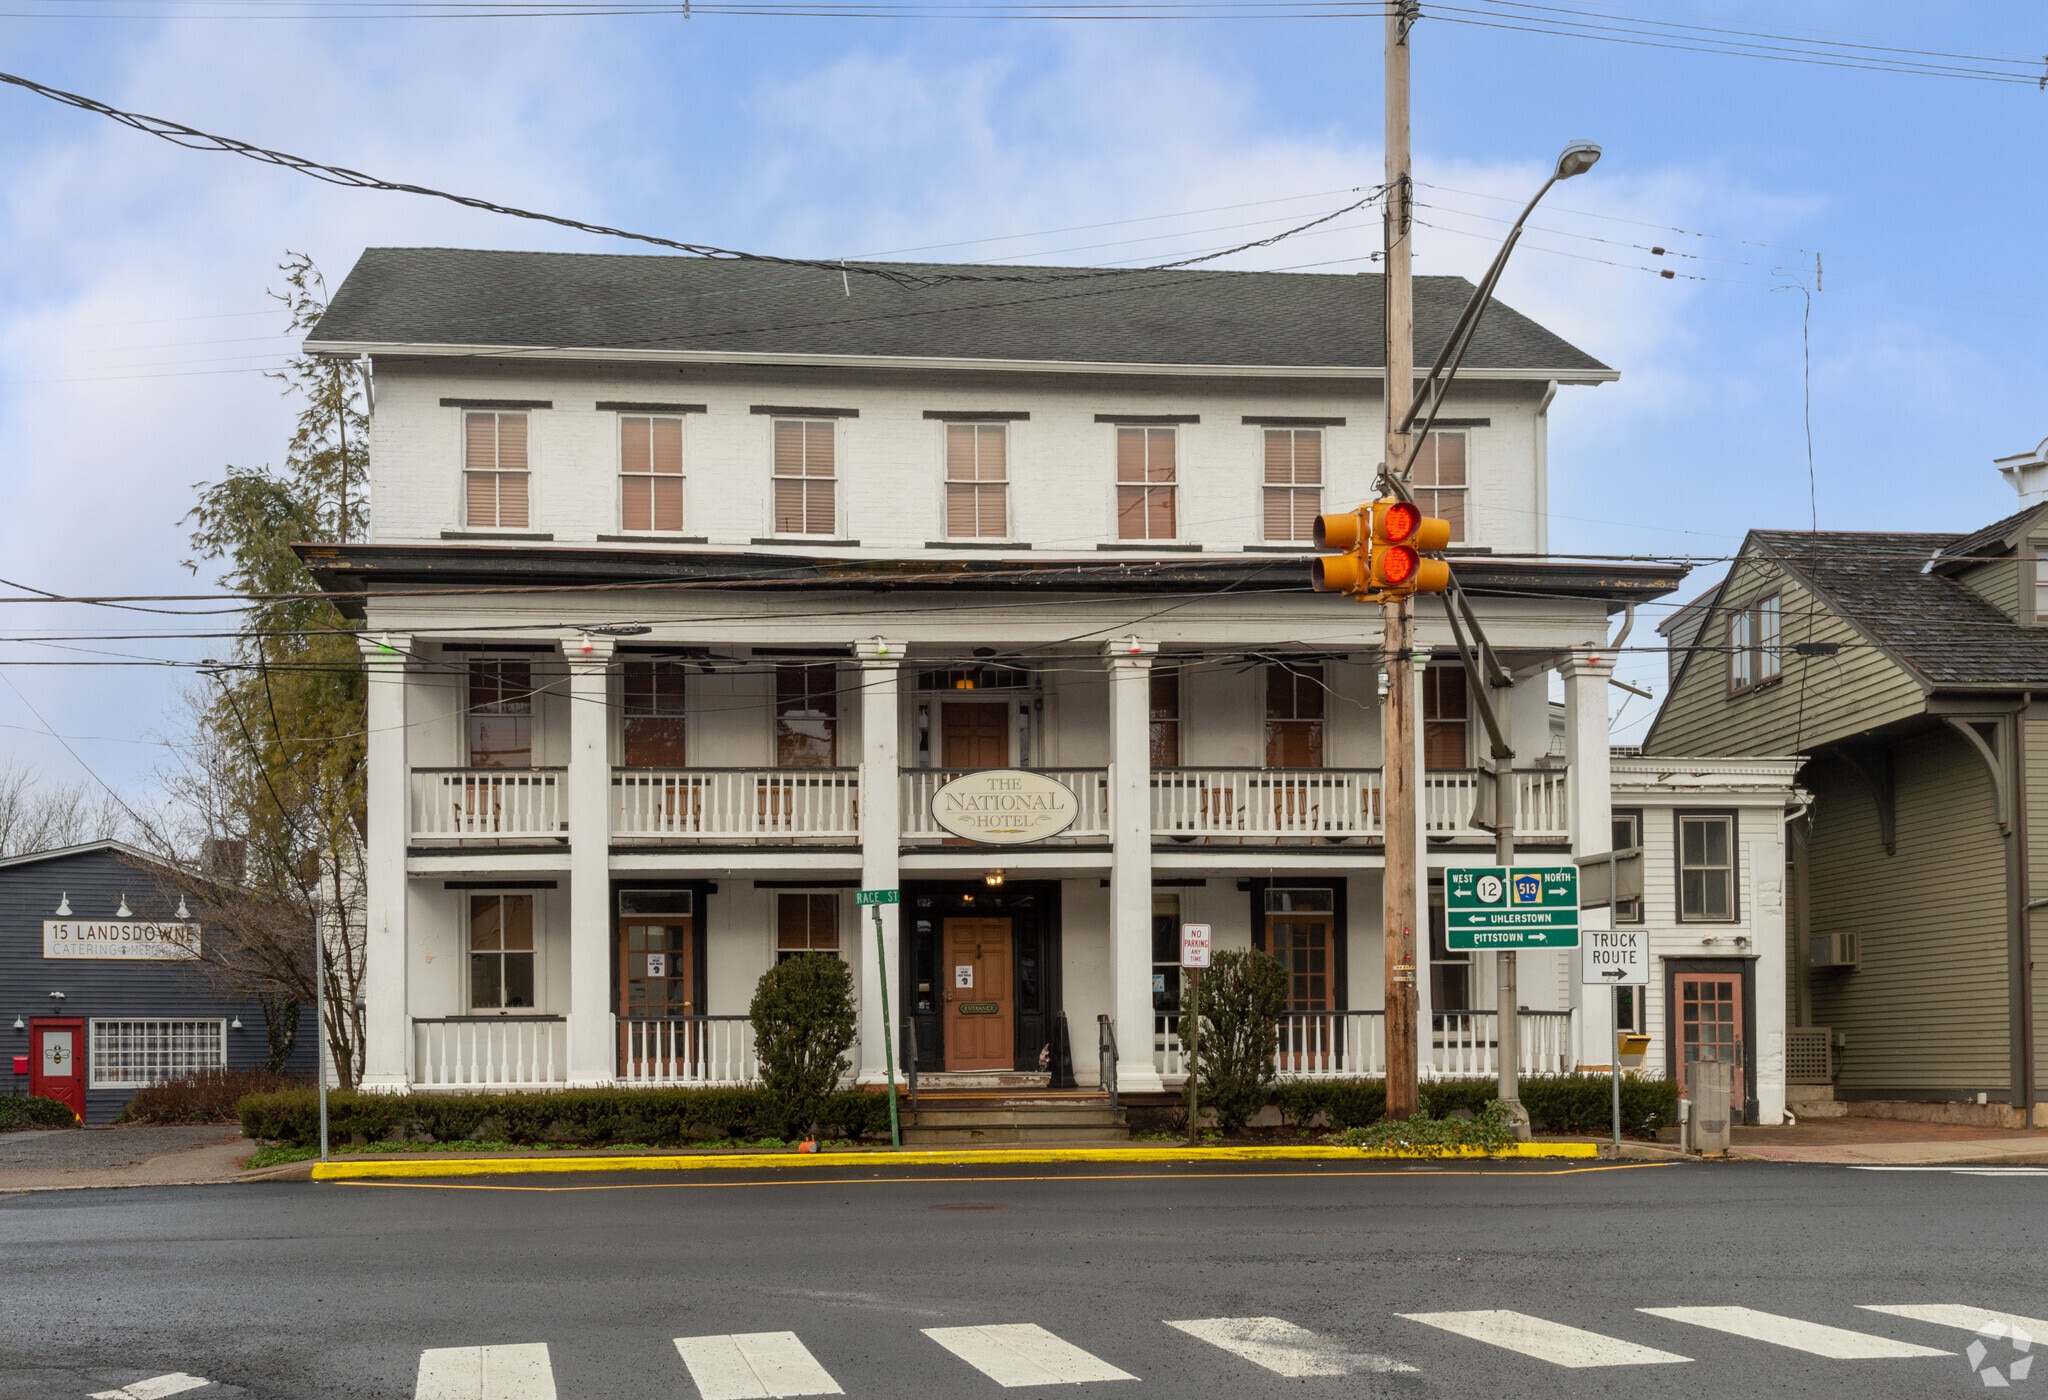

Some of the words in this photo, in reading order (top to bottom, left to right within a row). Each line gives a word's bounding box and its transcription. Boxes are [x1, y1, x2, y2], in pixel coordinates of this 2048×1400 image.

[986, 778, 1022, 790] THE
[945, 792, 1065, 811] NATIONAL
[976, 815, 1034, 827] HOTEL
[1452, 874, 1473, 883] WEST
[1482, 882, 1497, 896] 12
[1519, 883, 1537, 895] 513
[1544, 873, 1571, 883] NORTH
[856, 891, 880, 904] RACE
[887, 891, 898, 902] ST
[1490, 913, 1552, 923] UHLERSTOWN
[52, 924, 68, 940] 15
[77, 925, 194, 941] LANDSDOWNE
[1191, 929, 1202, 938] NO
[1473, 933, 1524, 943] PITTSTOWN
[1184, 939, 1209, 948] PARKING
[1592, 933, 1637, 947] TRUCK
[53, 943, 117, 955] CATERING
[1592, 950, 1637, 964] ROUTE
